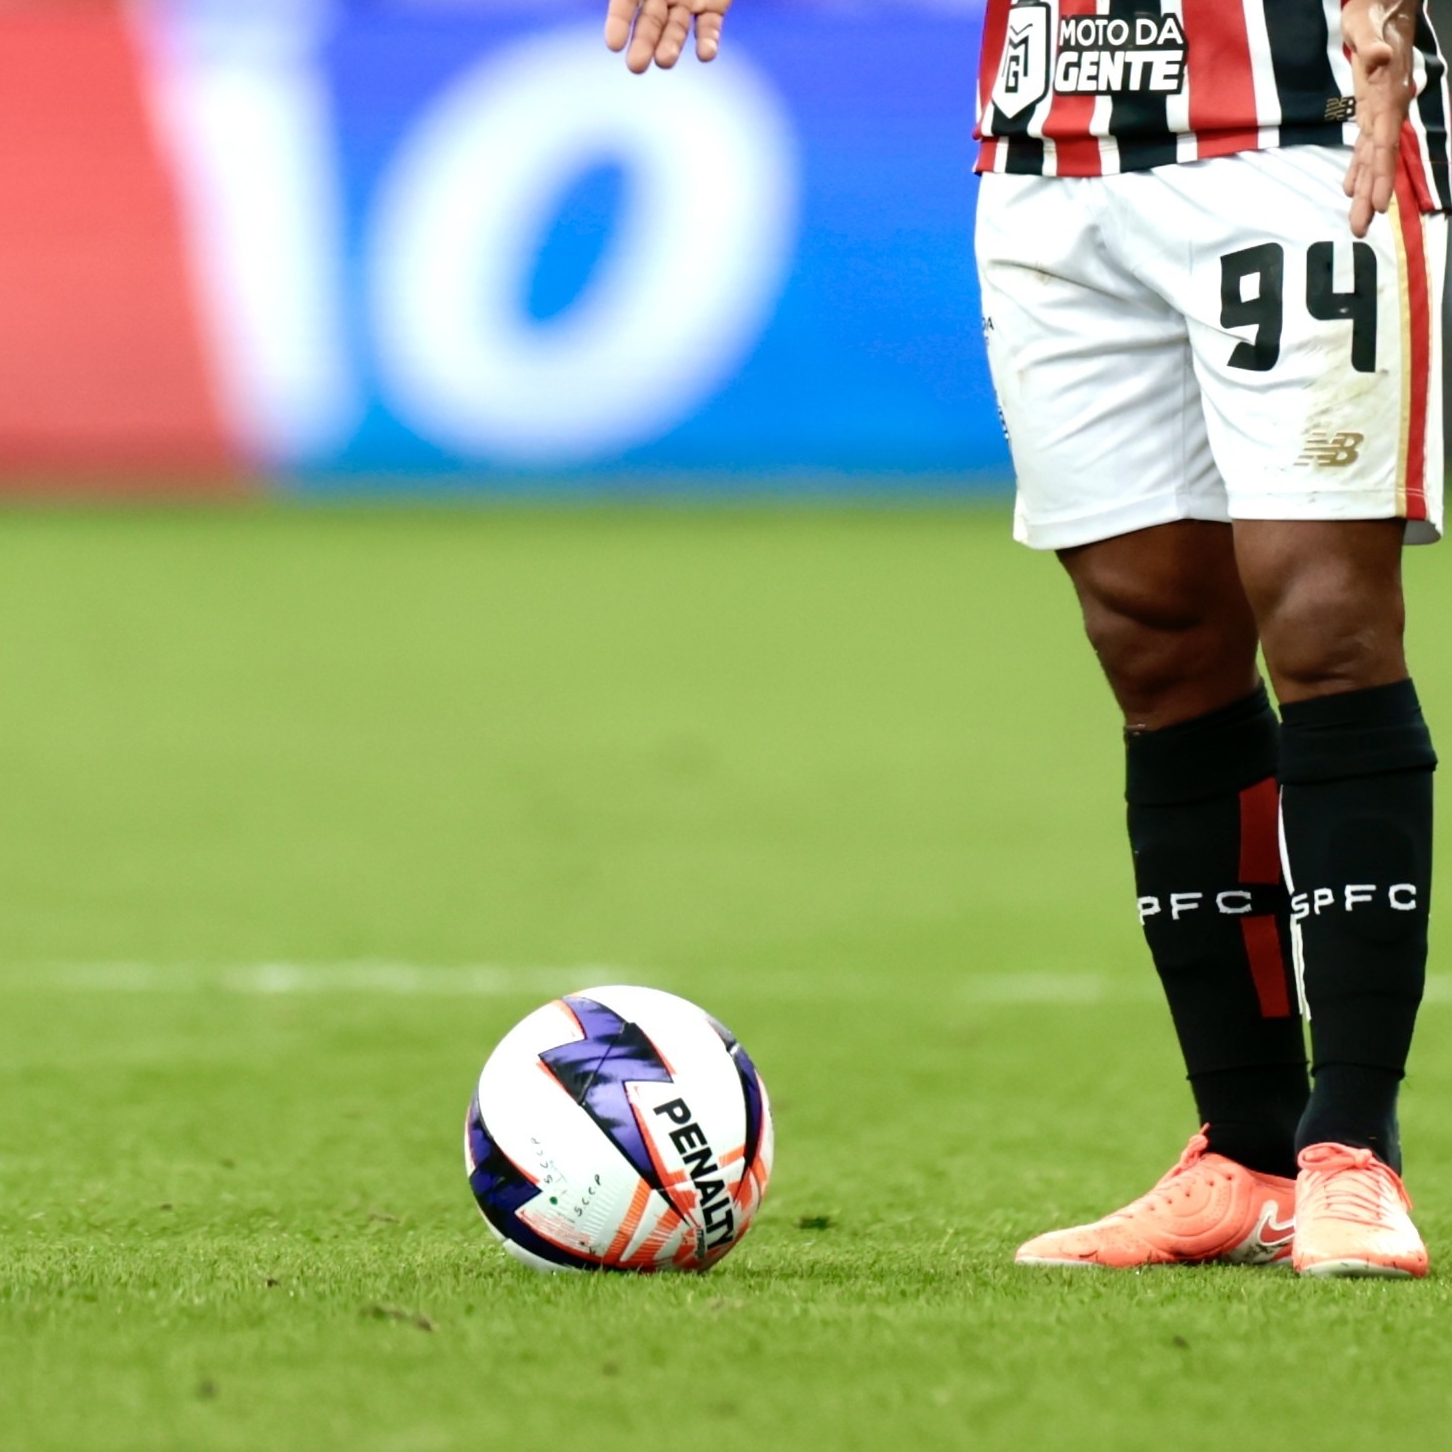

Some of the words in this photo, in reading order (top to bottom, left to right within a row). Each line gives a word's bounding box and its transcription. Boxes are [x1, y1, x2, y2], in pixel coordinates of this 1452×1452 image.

[1059, 19, 1129, 46] MOTO
[1135, 17, 1183, 45] DA
[1054, 50, 1183, 91] GENTE
[1220, 241, 1378, 373] 94
[1291, 883, 1417, 920] SPFC
[653, 1097, 734, 1250] PENALTY
